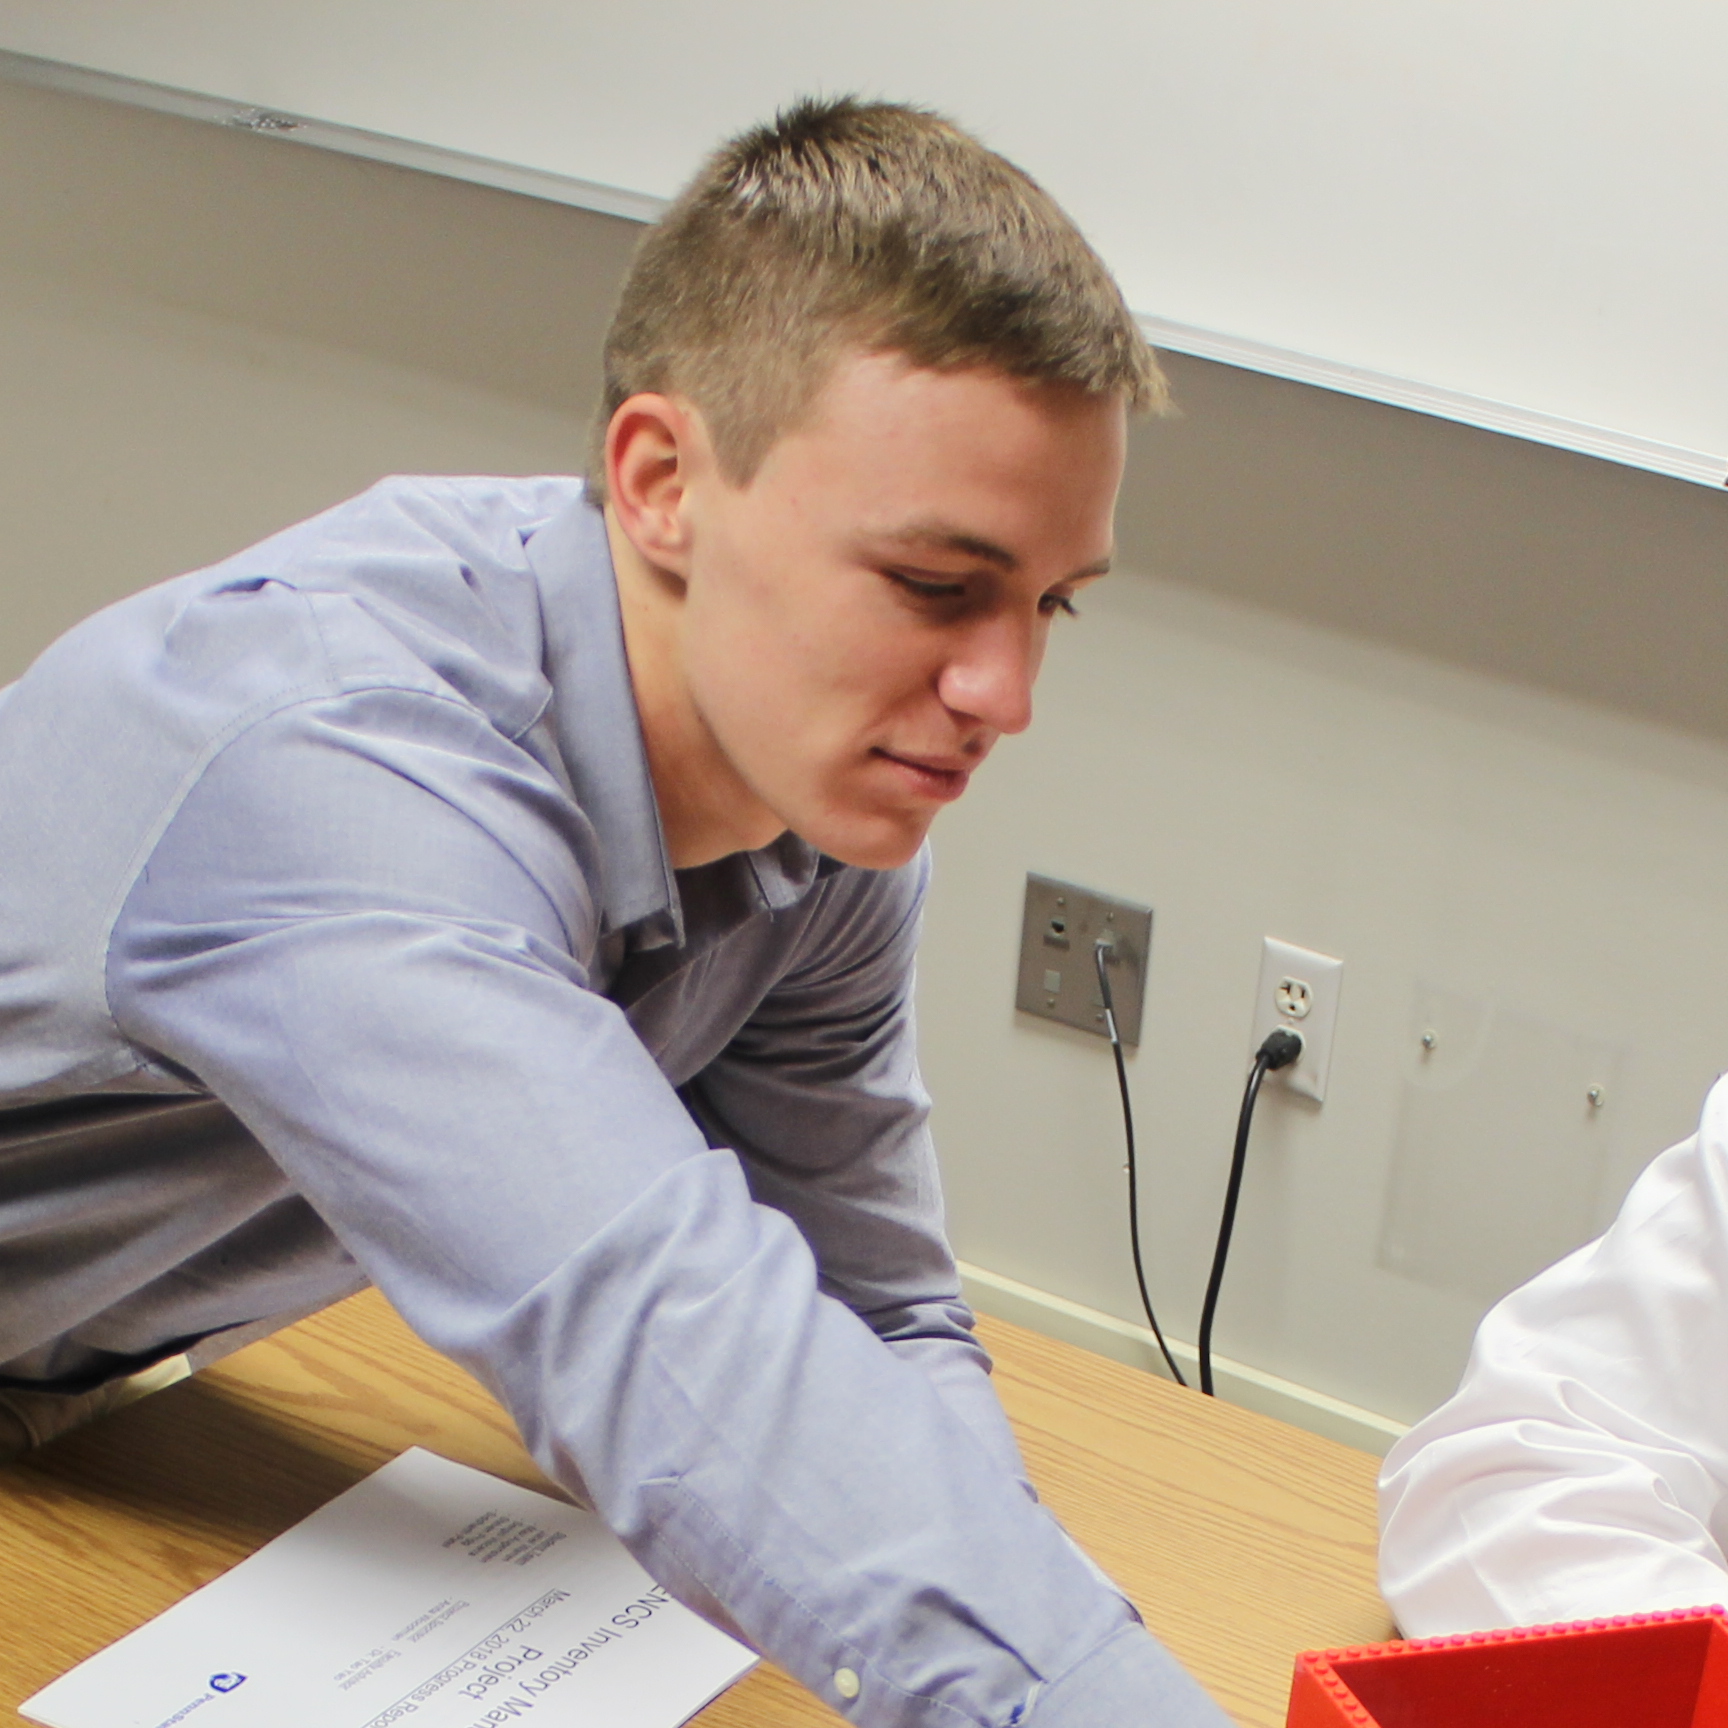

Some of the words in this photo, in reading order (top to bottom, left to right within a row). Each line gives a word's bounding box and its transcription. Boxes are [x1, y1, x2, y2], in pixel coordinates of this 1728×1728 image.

[524, 1588, 571, 1620] March
[470, 1633, 509, 1661] 2018
[518, 1627, 623, 1697] Inventory
[411, 1660, 476, 1702] Progress
[458, 1645, 544, 1700] Project
